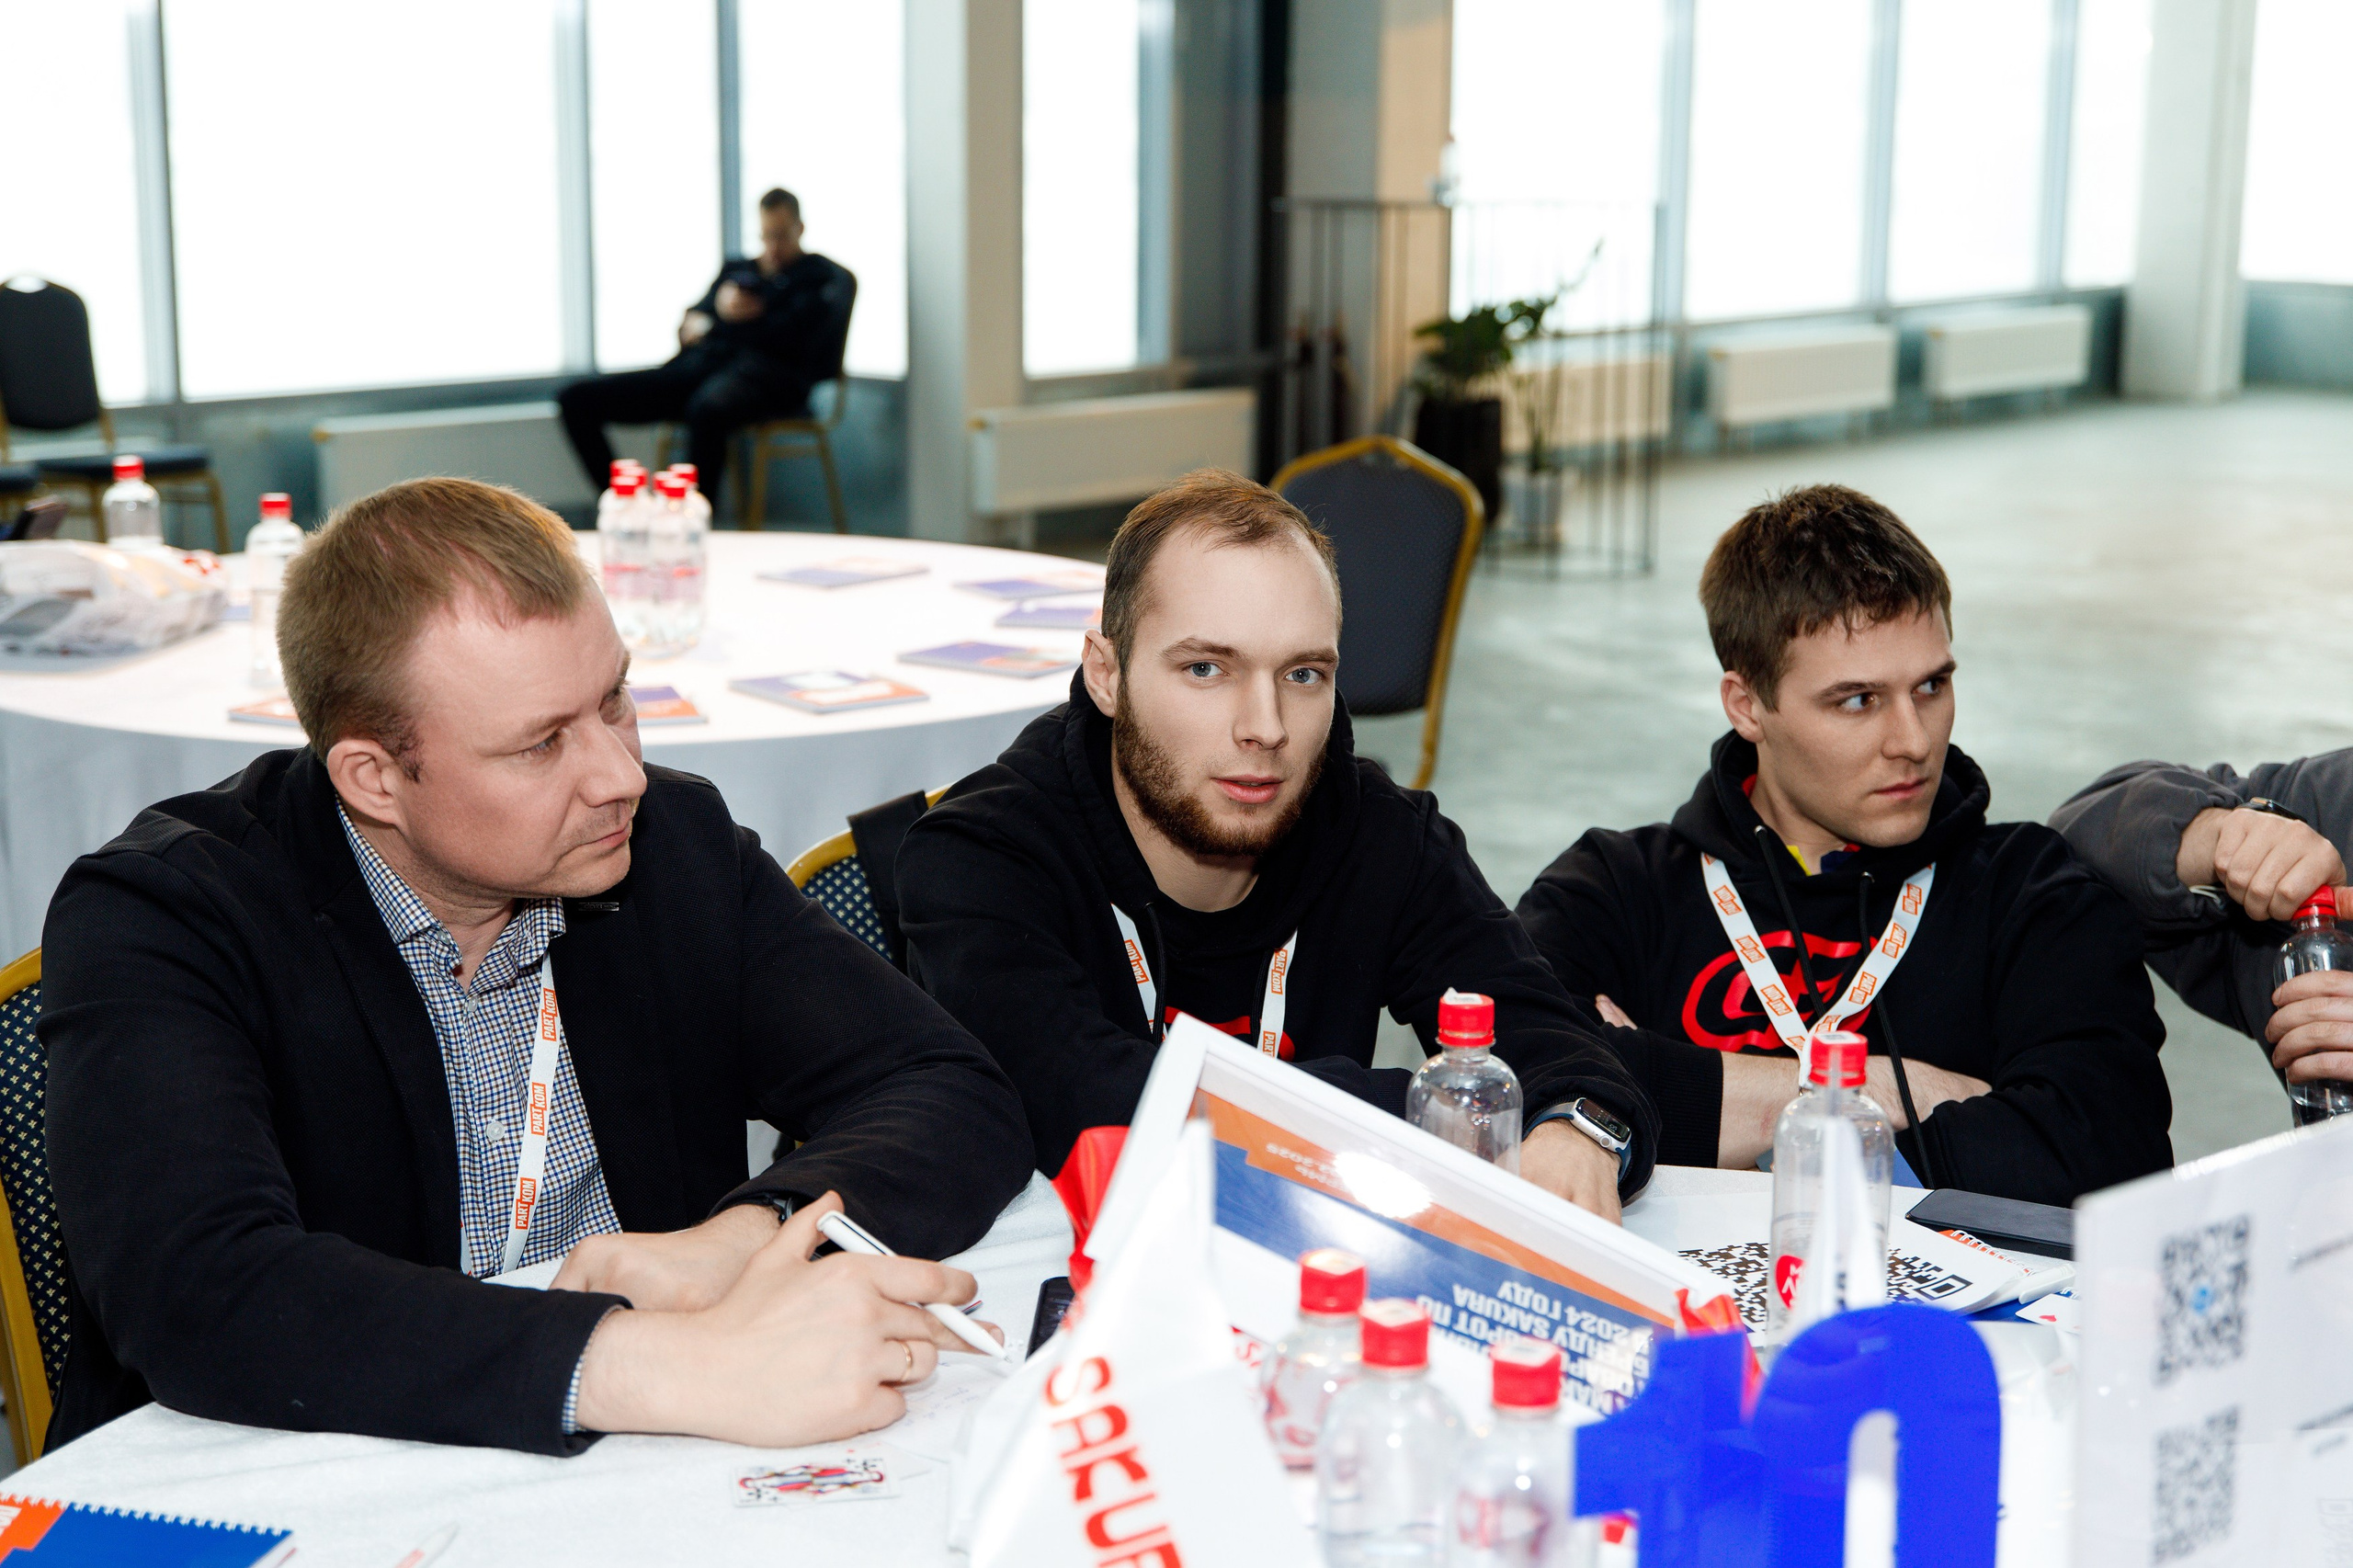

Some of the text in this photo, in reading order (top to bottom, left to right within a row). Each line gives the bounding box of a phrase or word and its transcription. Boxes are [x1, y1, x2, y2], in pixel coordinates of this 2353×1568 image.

[1452, 1283, 1551, 1340] SAKURA
[1496, 1280, 1563, 1321] ГОДУ
[1564, 1305, 1630, 1346] 2024
